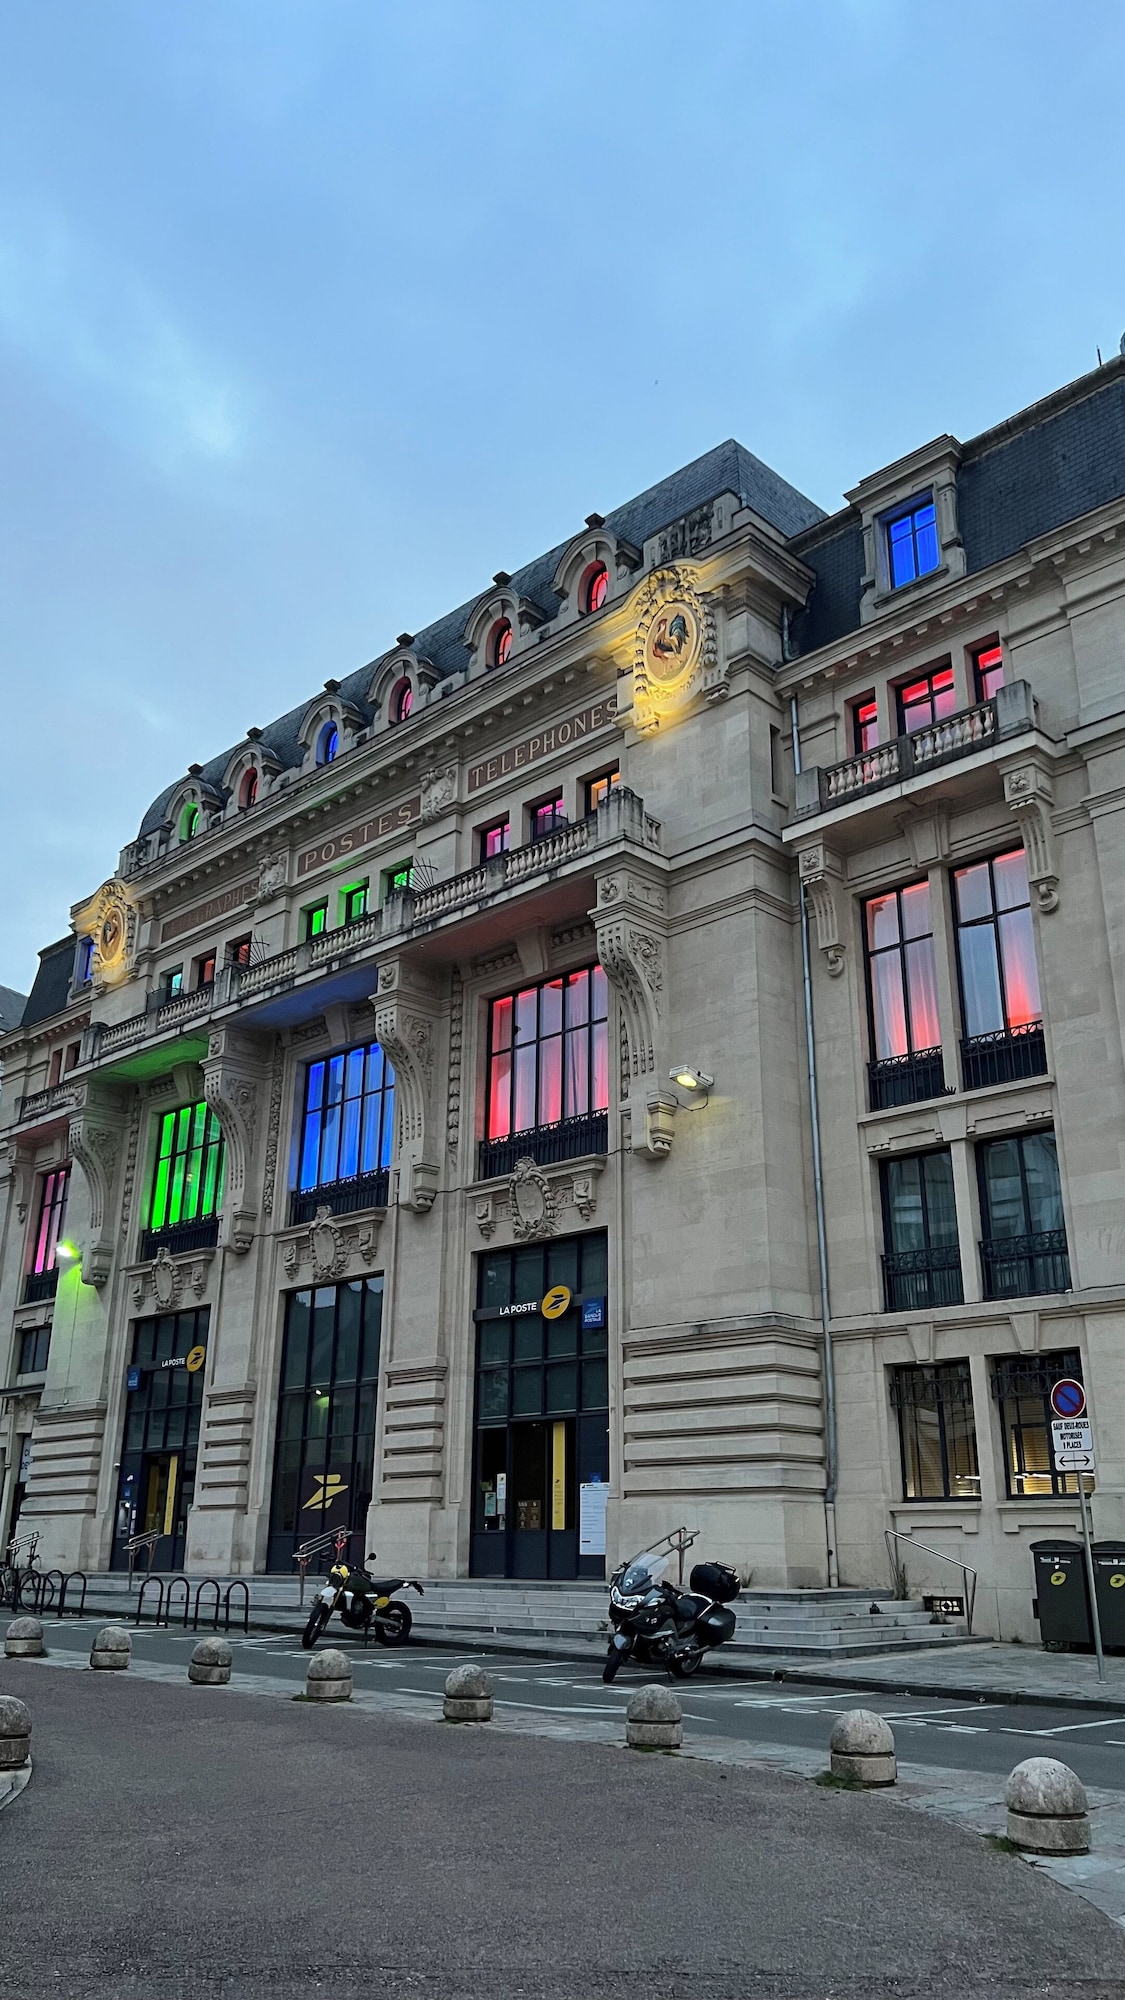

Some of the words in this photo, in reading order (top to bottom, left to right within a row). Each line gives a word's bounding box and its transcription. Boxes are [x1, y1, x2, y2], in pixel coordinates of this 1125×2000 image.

[471, 698, 618, 787] TELEPHONES
[304, 804, 412, 871] POSTES
[163, 880, 259, 940] ELEGRAPHES
[499, 1306, 510, 1315] LA
[510, 1302, 537, 1313] POSTE
[161, 1360, 169, 1368] LA
[168, 1357, 185, 1366] POSTE
